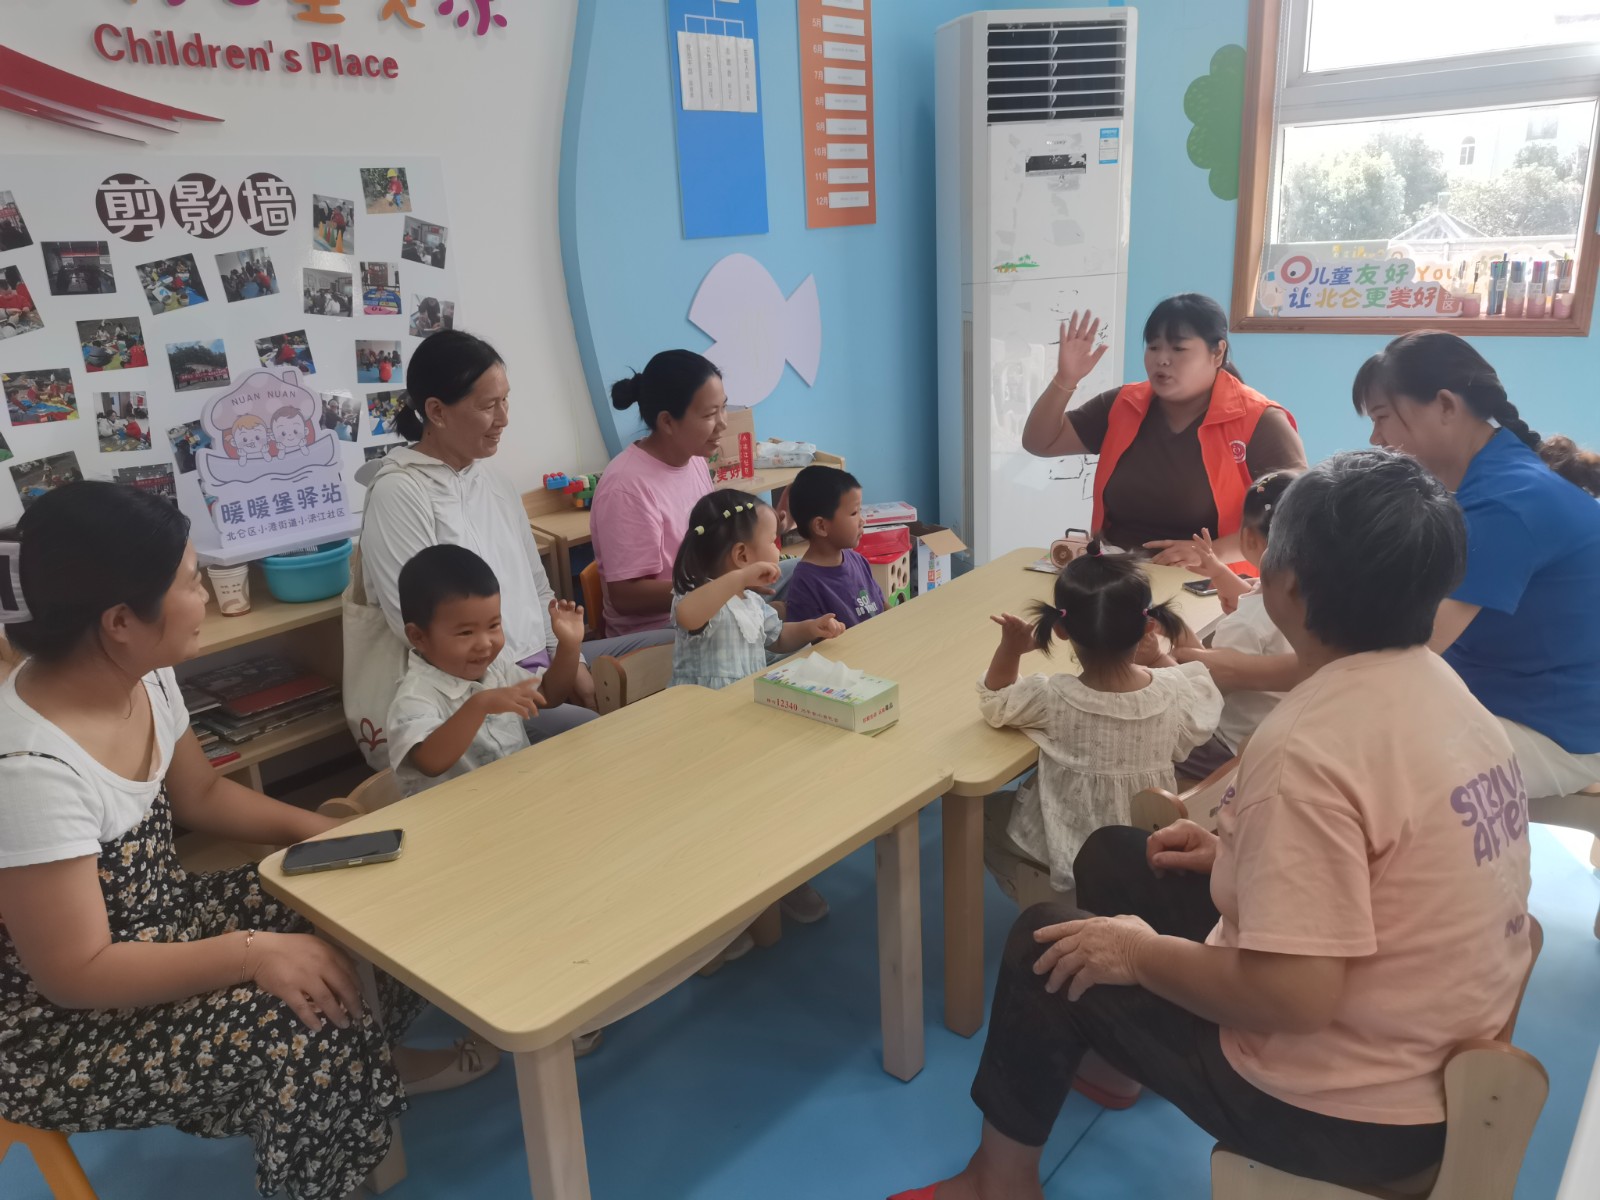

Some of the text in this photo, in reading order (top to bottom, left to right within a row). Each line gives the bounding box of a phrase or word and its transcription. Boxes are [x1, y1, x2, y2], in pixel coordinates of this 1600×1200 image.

[94, 23, 399, 79] Children's Place
[101, 175, 295, 239] 剪影墙
[1308, 263, 1410, 286] 儿童友好
[1288, 286, 1438, 309] 让北仑更美好
[231, 390, 297, 406] NUAN NUAN
[220, 482, 342, 525] 暖暖堡驿站
[776, 698, 798, 711] 12340
